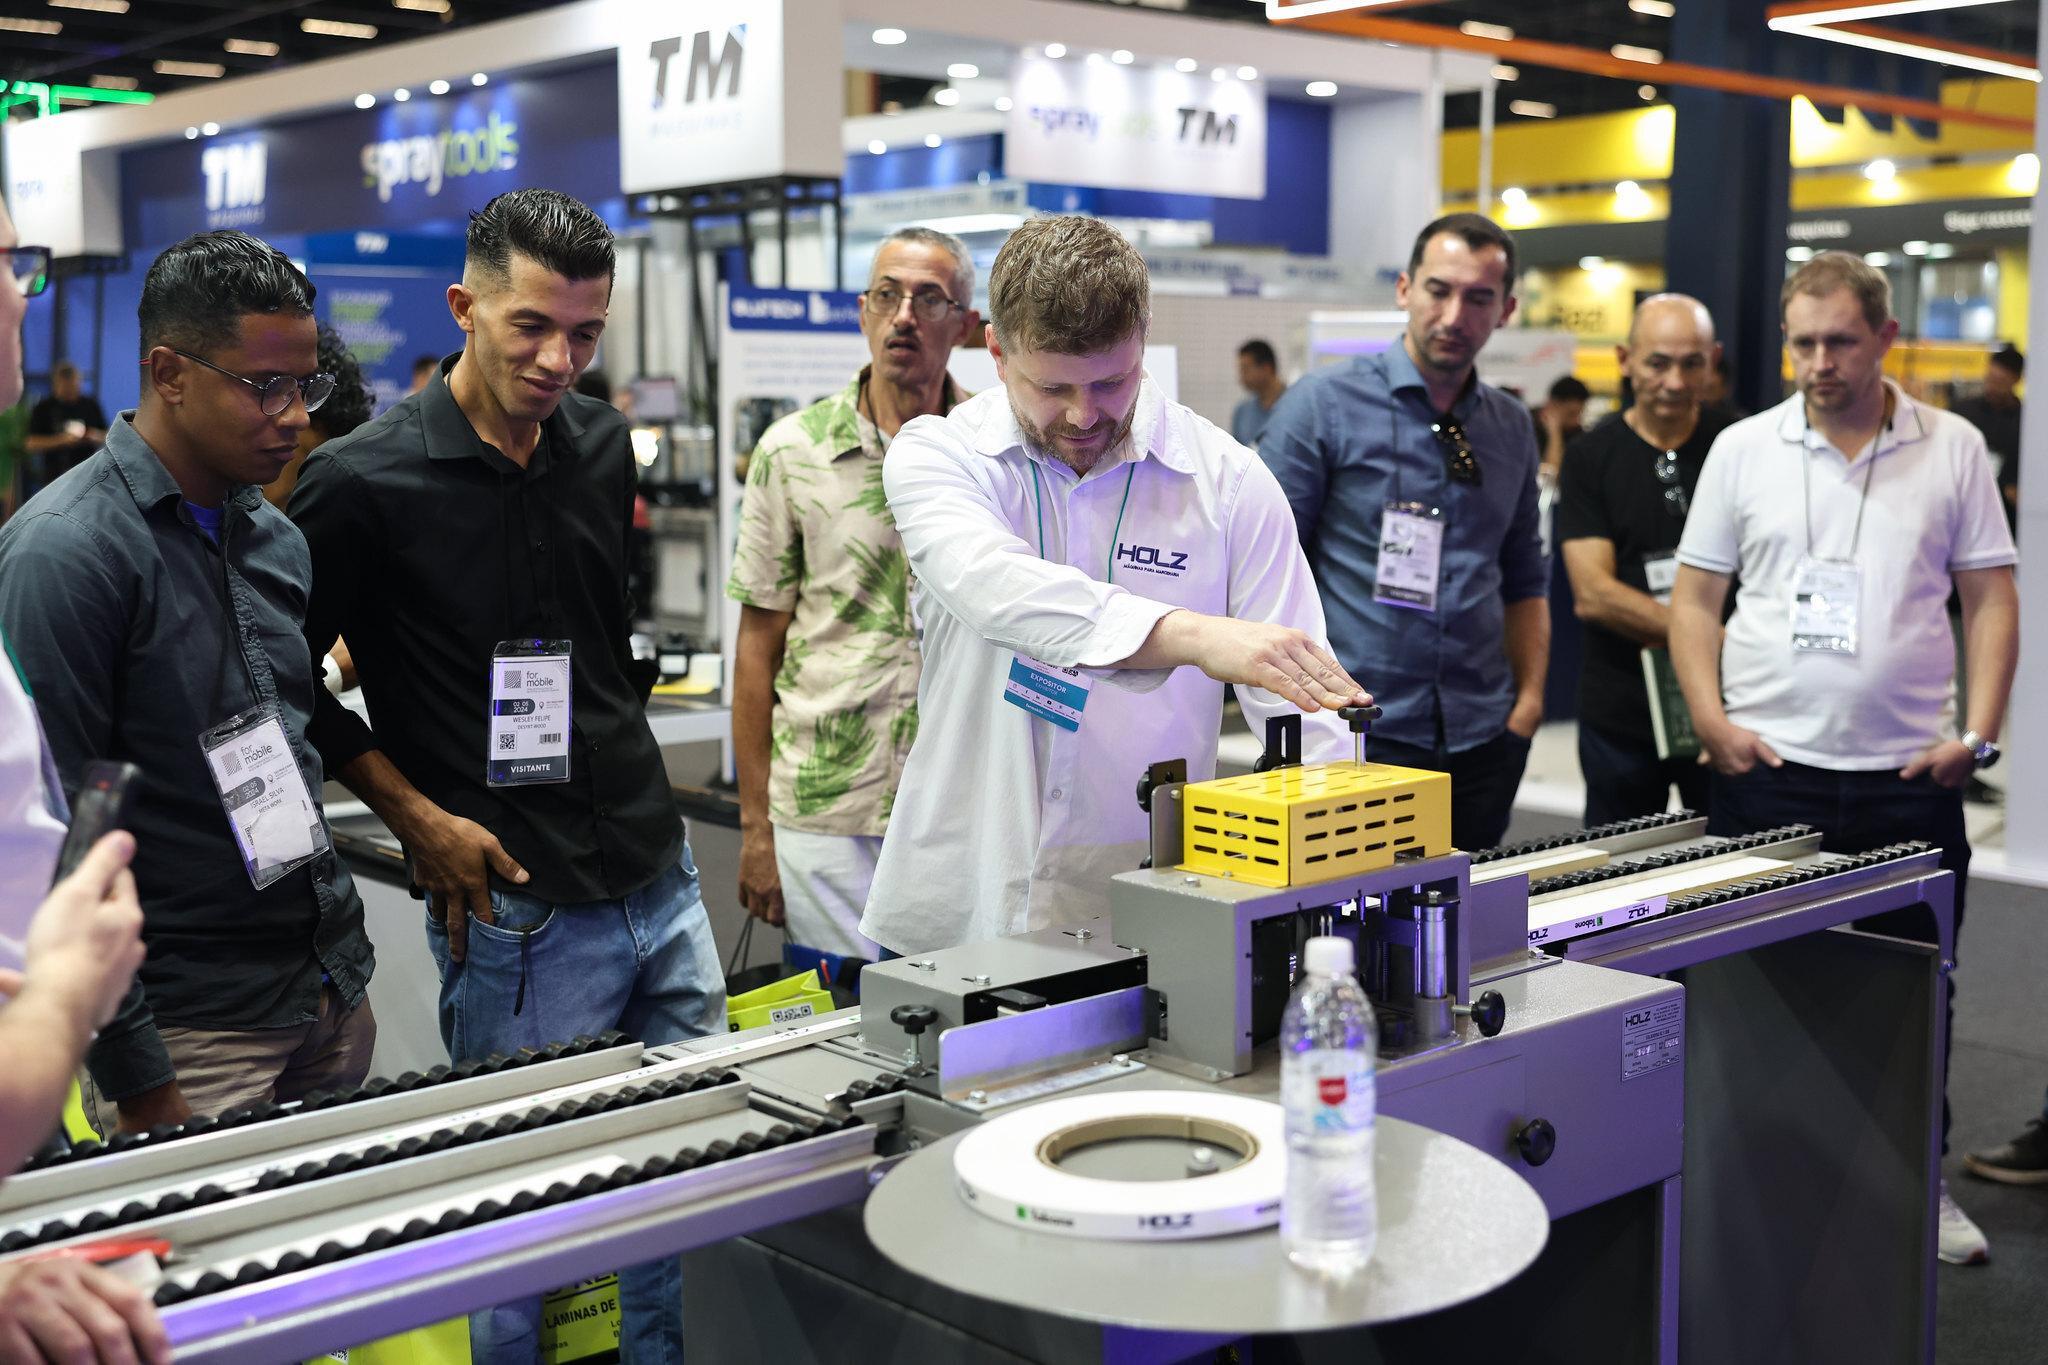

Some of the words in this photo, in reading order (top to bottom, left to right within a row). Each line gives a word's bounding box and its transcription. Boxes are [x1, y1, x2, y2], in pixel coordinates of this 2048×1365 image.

[648, 23, 748, 110] TM
[1177, 107, 1239, 146] TM
[1117, 543, 1188, 570] HOLZ
[526, 671, 538, 679] for
[1030, 672, 1067, 694] EXPOSITOR
[534, 714, 551, 722] FELIPE
[240, 744, 253, 756] for
[510, 763, 551, 774] VISITANTE
[251, 797, 269, 809] ISRAEL
[268, 787, 285, 800] SILVA
[1628, 906, 1649, 919] HOLZ
[1626, 1011, 1651, 1027] HOLZ
[1138, 1214, 1192, 1228] HOLZ
[600, 1299, 617, 1313] DE
